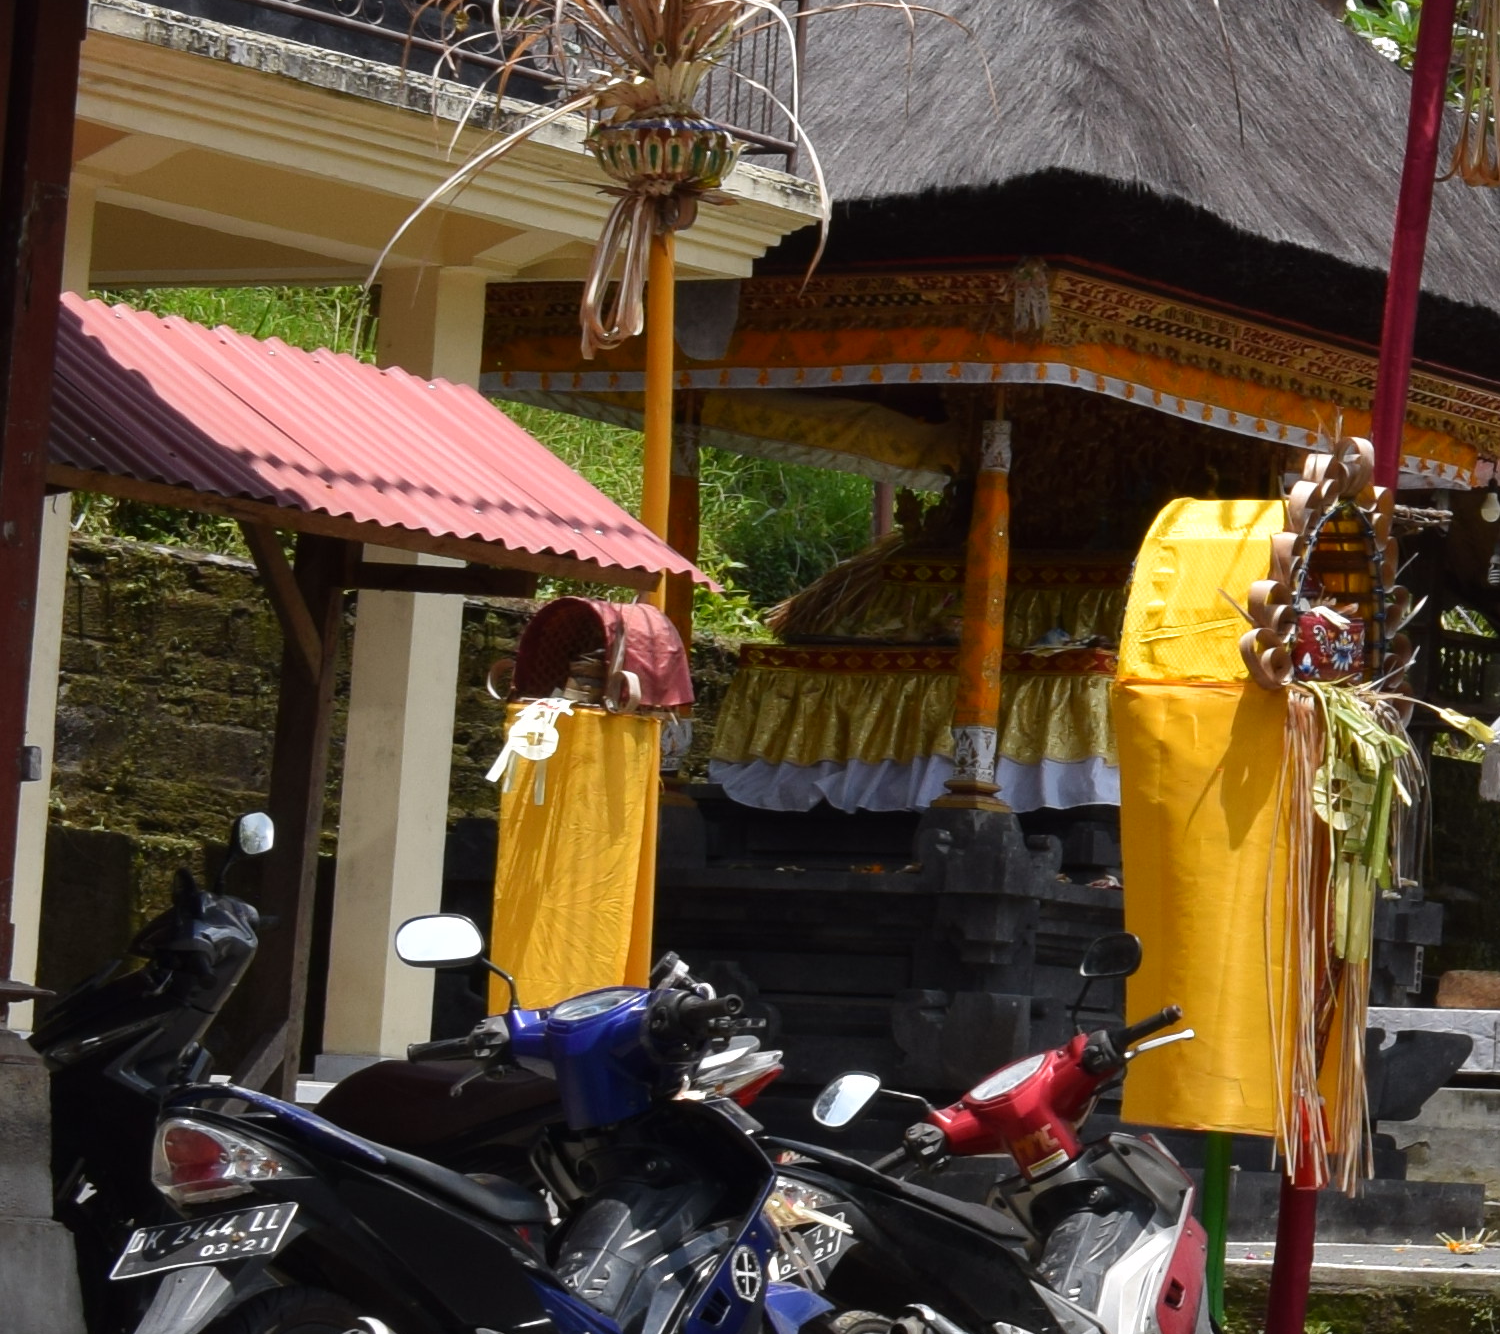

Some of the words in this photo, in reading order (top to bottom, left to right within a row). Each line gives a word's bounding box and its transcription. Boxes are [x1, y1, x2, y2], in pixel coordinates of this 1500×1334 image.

[126, 1229, 166, 1254] DK
[171, 1214, 240, 1246] 2444
[249, 1209, 281, 1233] LL
